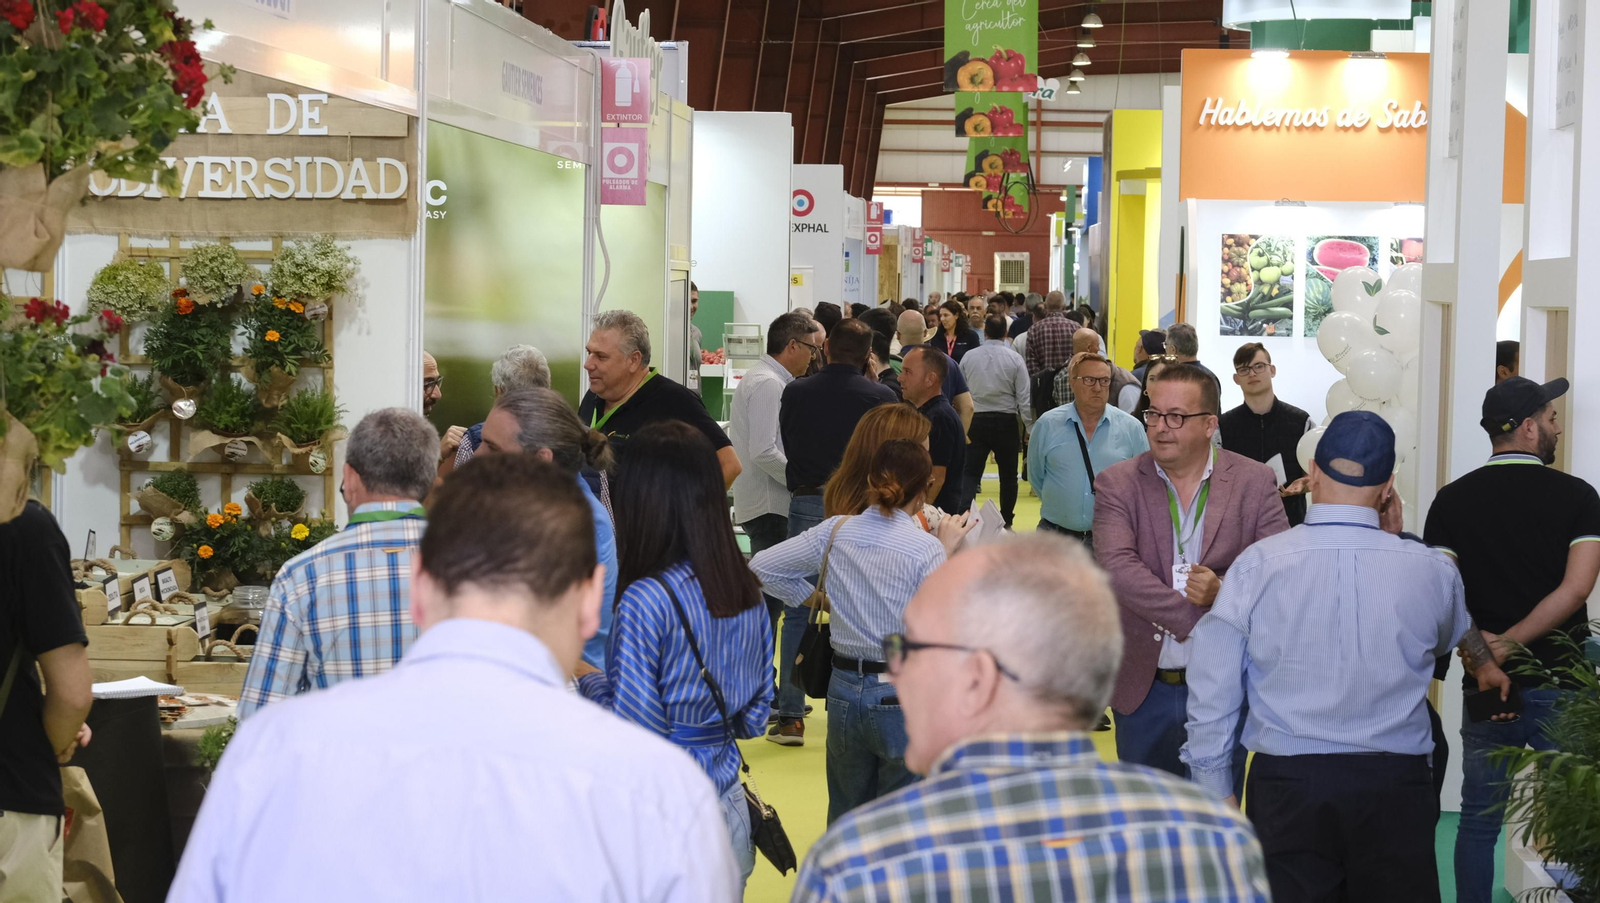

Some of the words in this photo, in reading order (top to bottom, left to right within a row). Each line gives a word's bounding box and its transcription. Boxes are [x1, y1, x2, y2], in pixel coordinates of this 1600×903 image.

[266, 93, 329, 135] DE
[606, 113, 643, 121] EXTINTOR
[1199, 97, 1329, 128] Hablemos
[1336, 100, 1371, 128] de
[557, 160, 585, 169] SEM
